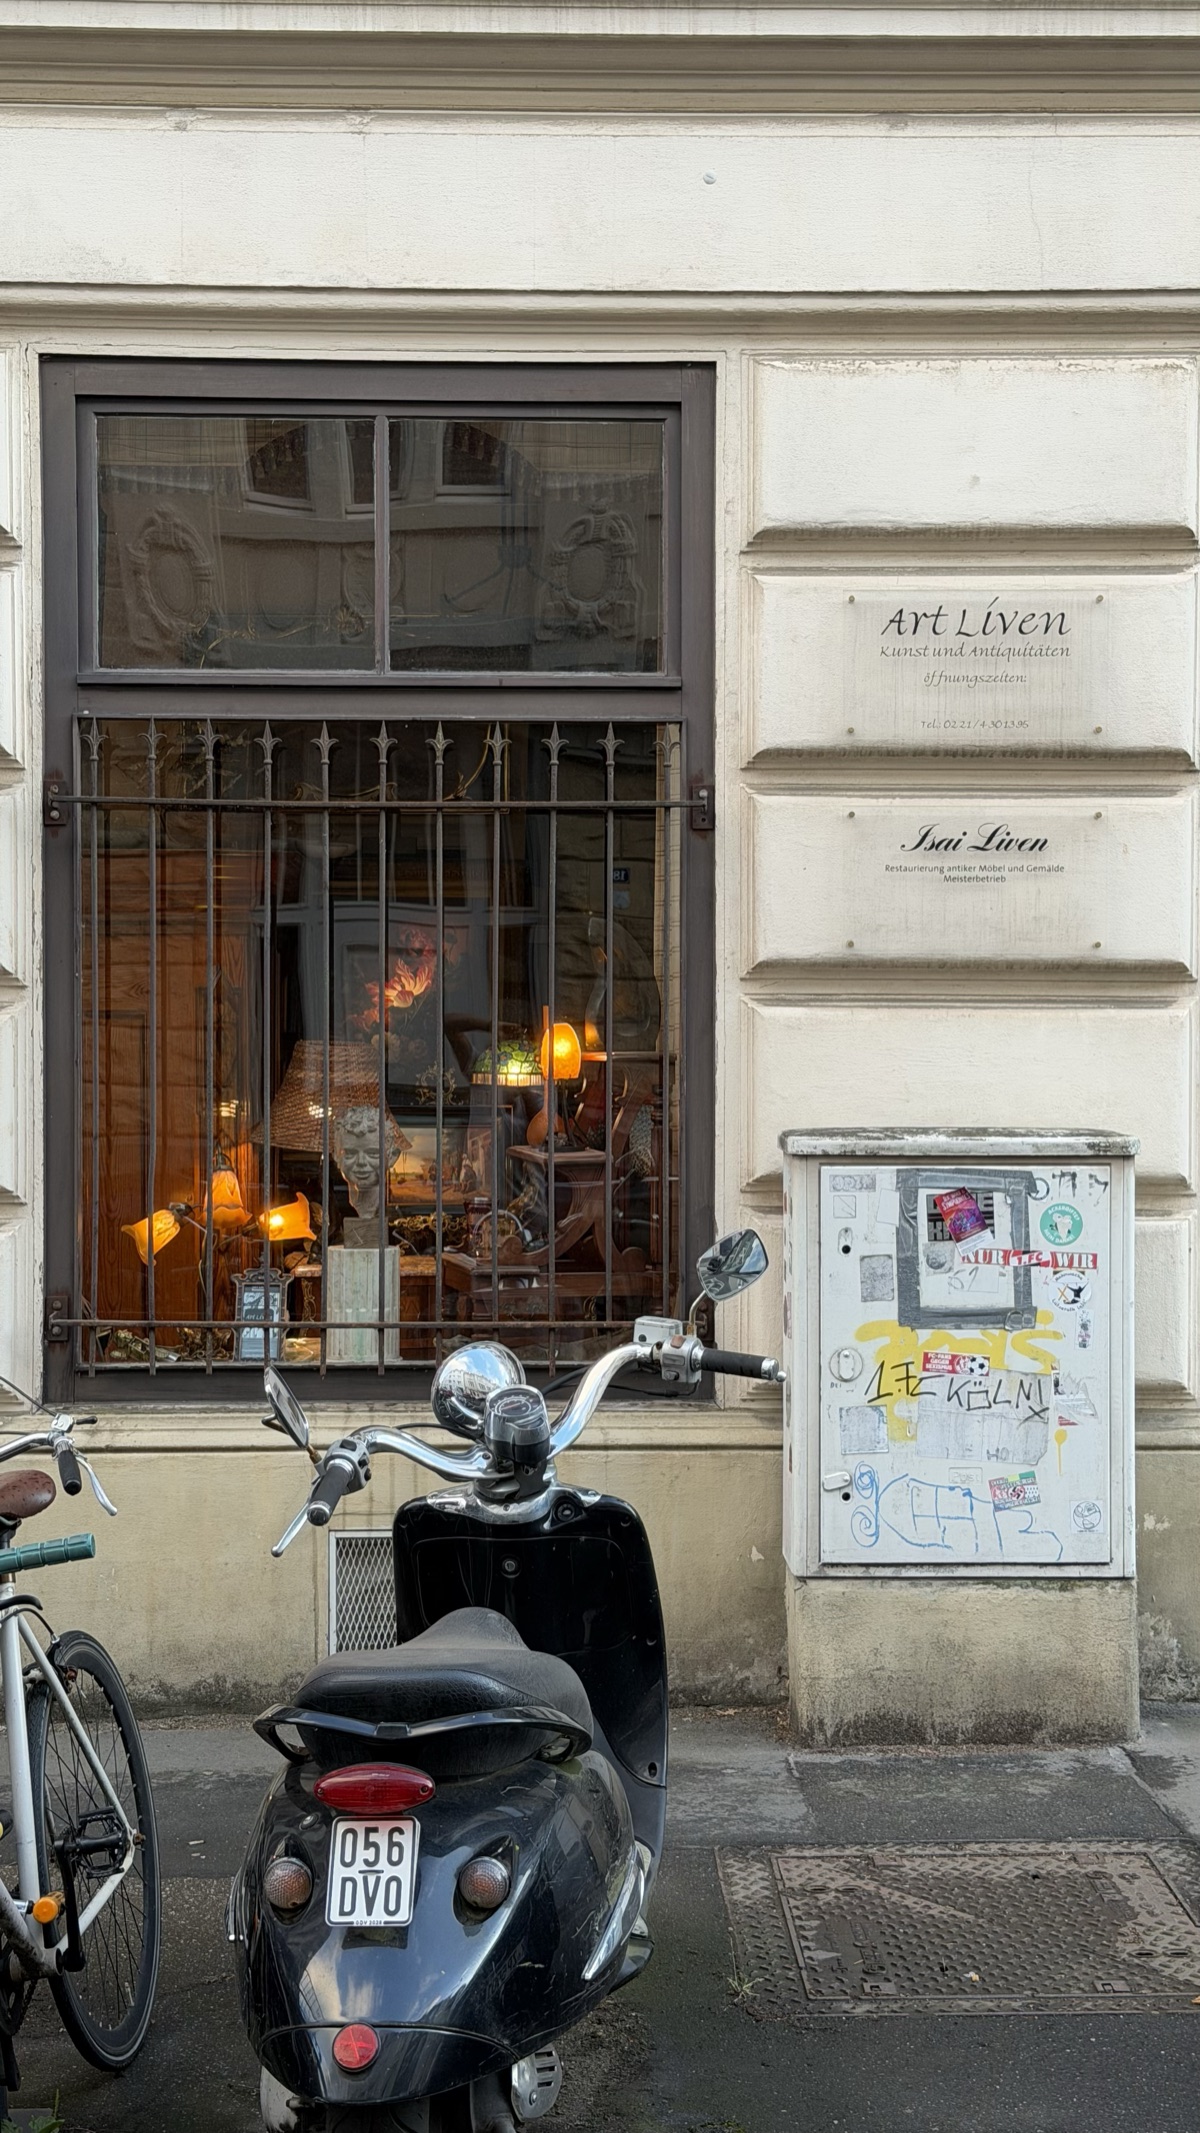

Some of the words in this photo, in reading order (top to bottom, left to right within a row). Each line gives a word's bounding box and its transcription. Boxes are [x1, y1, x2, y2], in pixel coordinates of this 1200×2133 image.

[880, 604, 949, 636] Art
[880, 644, 930, 658] Kunst
[932, 641, 966, 658] und
[900, 823, 968, 852] Isai
[966, 822, 1050, 852] Liven
[884, 864, 945, 875] Restaurierung
[946, 864, 977, 873] antiker
[978, 864, 1006, 873] Möbel
[1007, 864, 1024, 873] und
[1026, 864, 1065, 873] Gemälde
[943, 874, 1007, 884] Meisterbetrieb
[1055, 1252, 1094, 1268] WIR
[340, 1826, 405, 1867] 056
[338, 1875, 403, 1917] DVO
